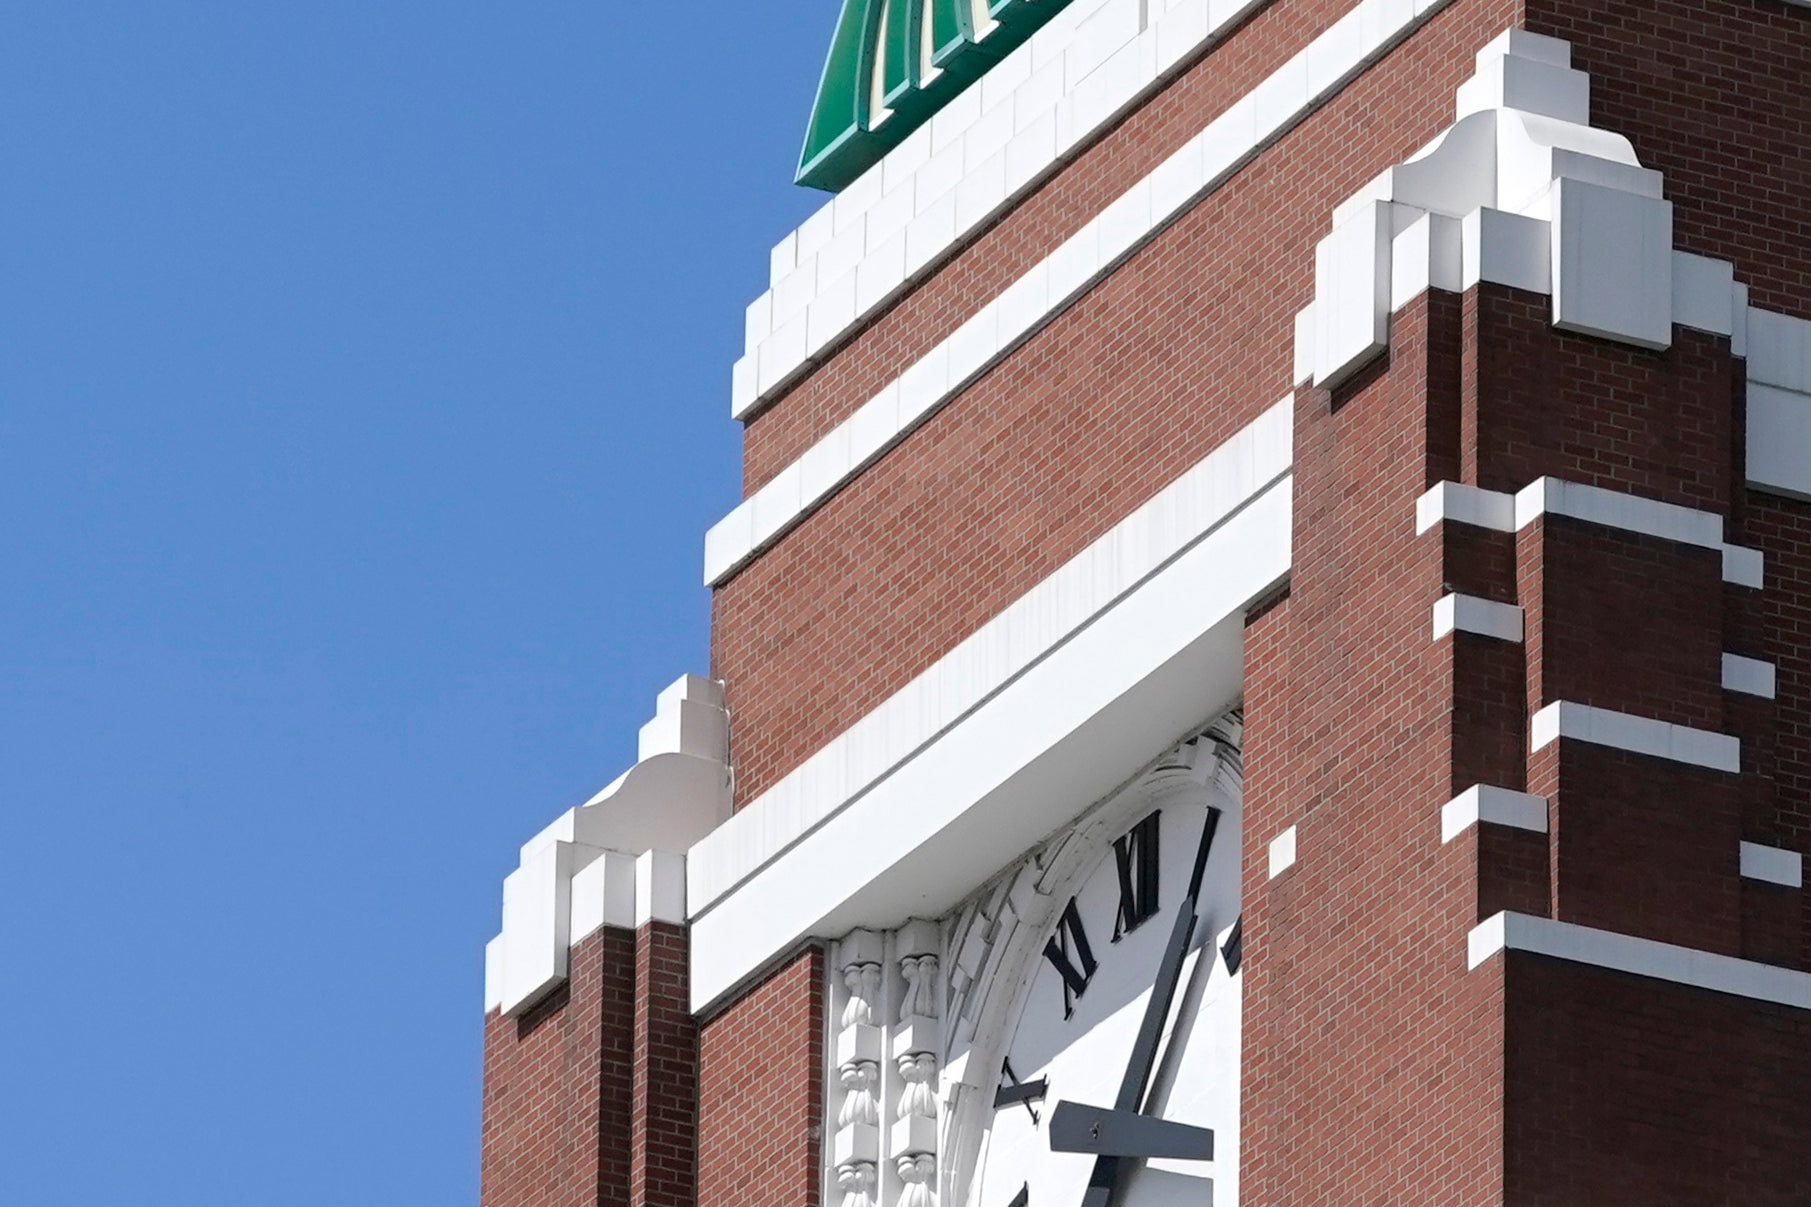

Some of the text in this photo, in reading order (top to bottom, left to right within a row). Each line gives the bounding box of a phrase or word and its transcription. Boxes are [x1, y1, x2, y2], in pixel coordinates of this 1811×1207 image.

[1110, 808, 1162, 943] XII
[1042, 895, 1100, 1021] XI
[993, 1055, 1050, 1128] X
